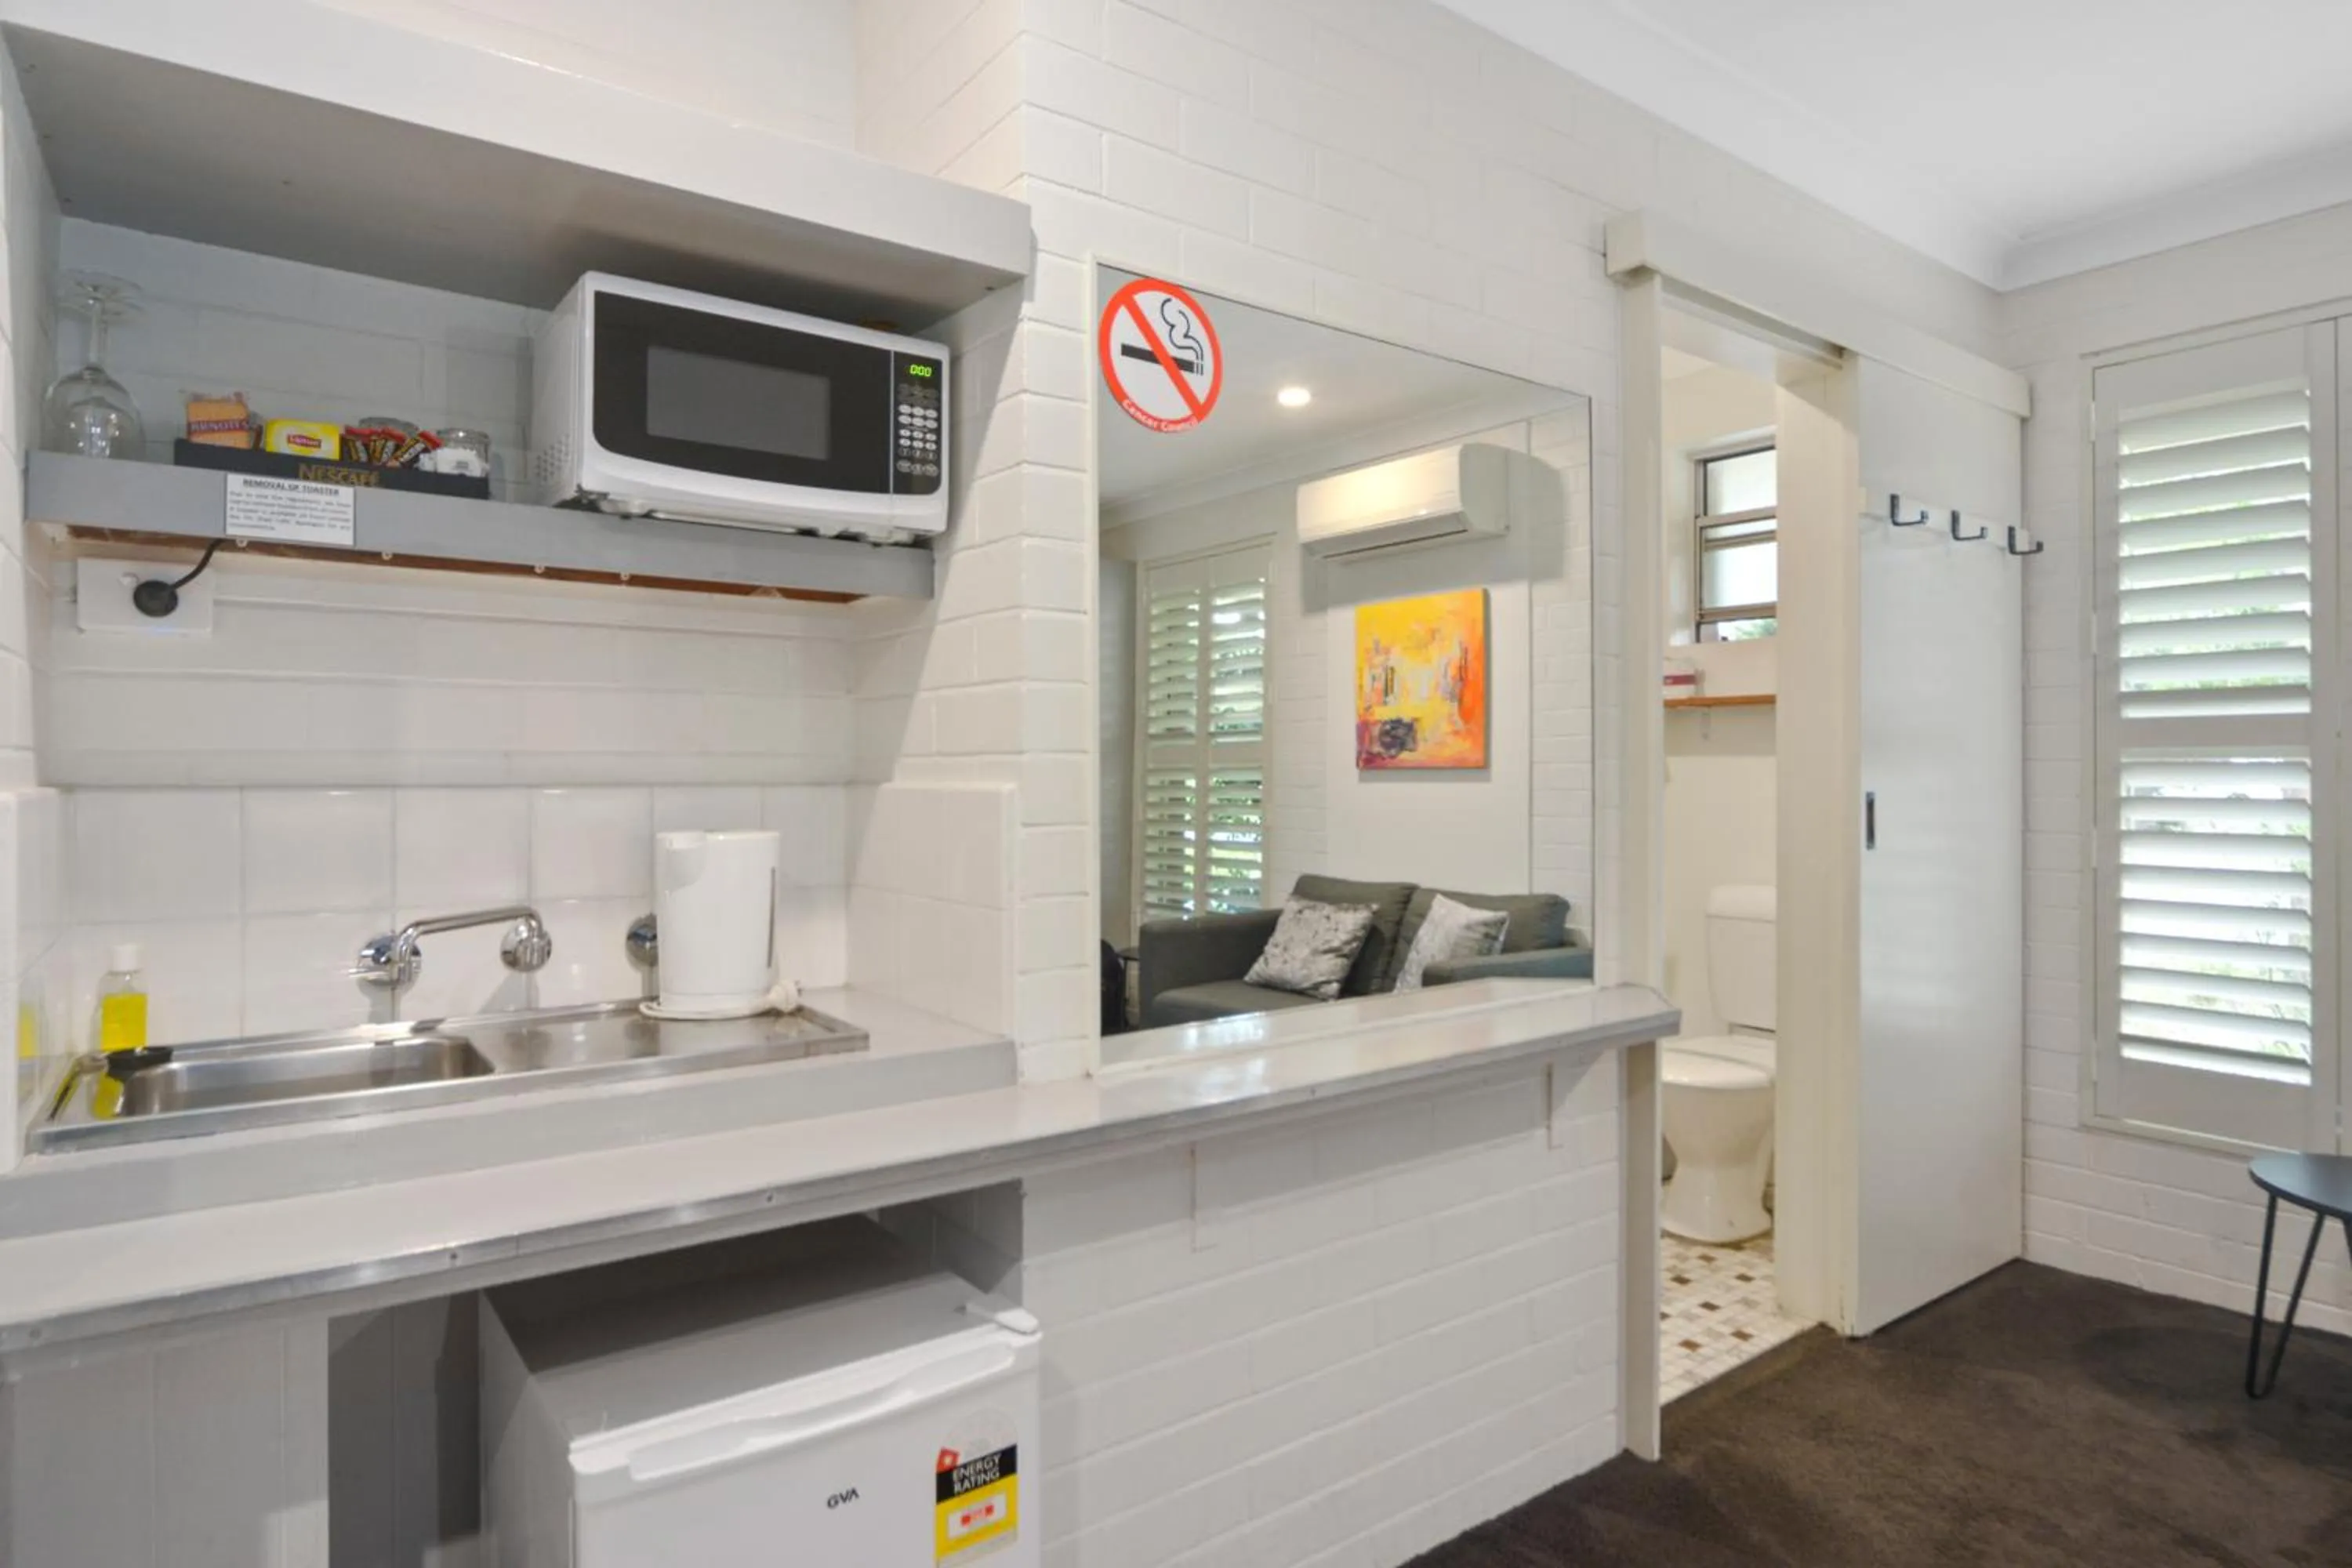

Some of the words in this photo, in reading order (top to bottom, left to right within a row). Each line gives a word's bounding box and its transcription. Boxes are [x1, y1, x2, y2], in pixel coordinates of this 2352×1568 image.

[953, 1453, 1001, 1481] ENERGY
[953, 1469, 1000, 1494] RATING
[827, 1487, 859, 1510] GVA
